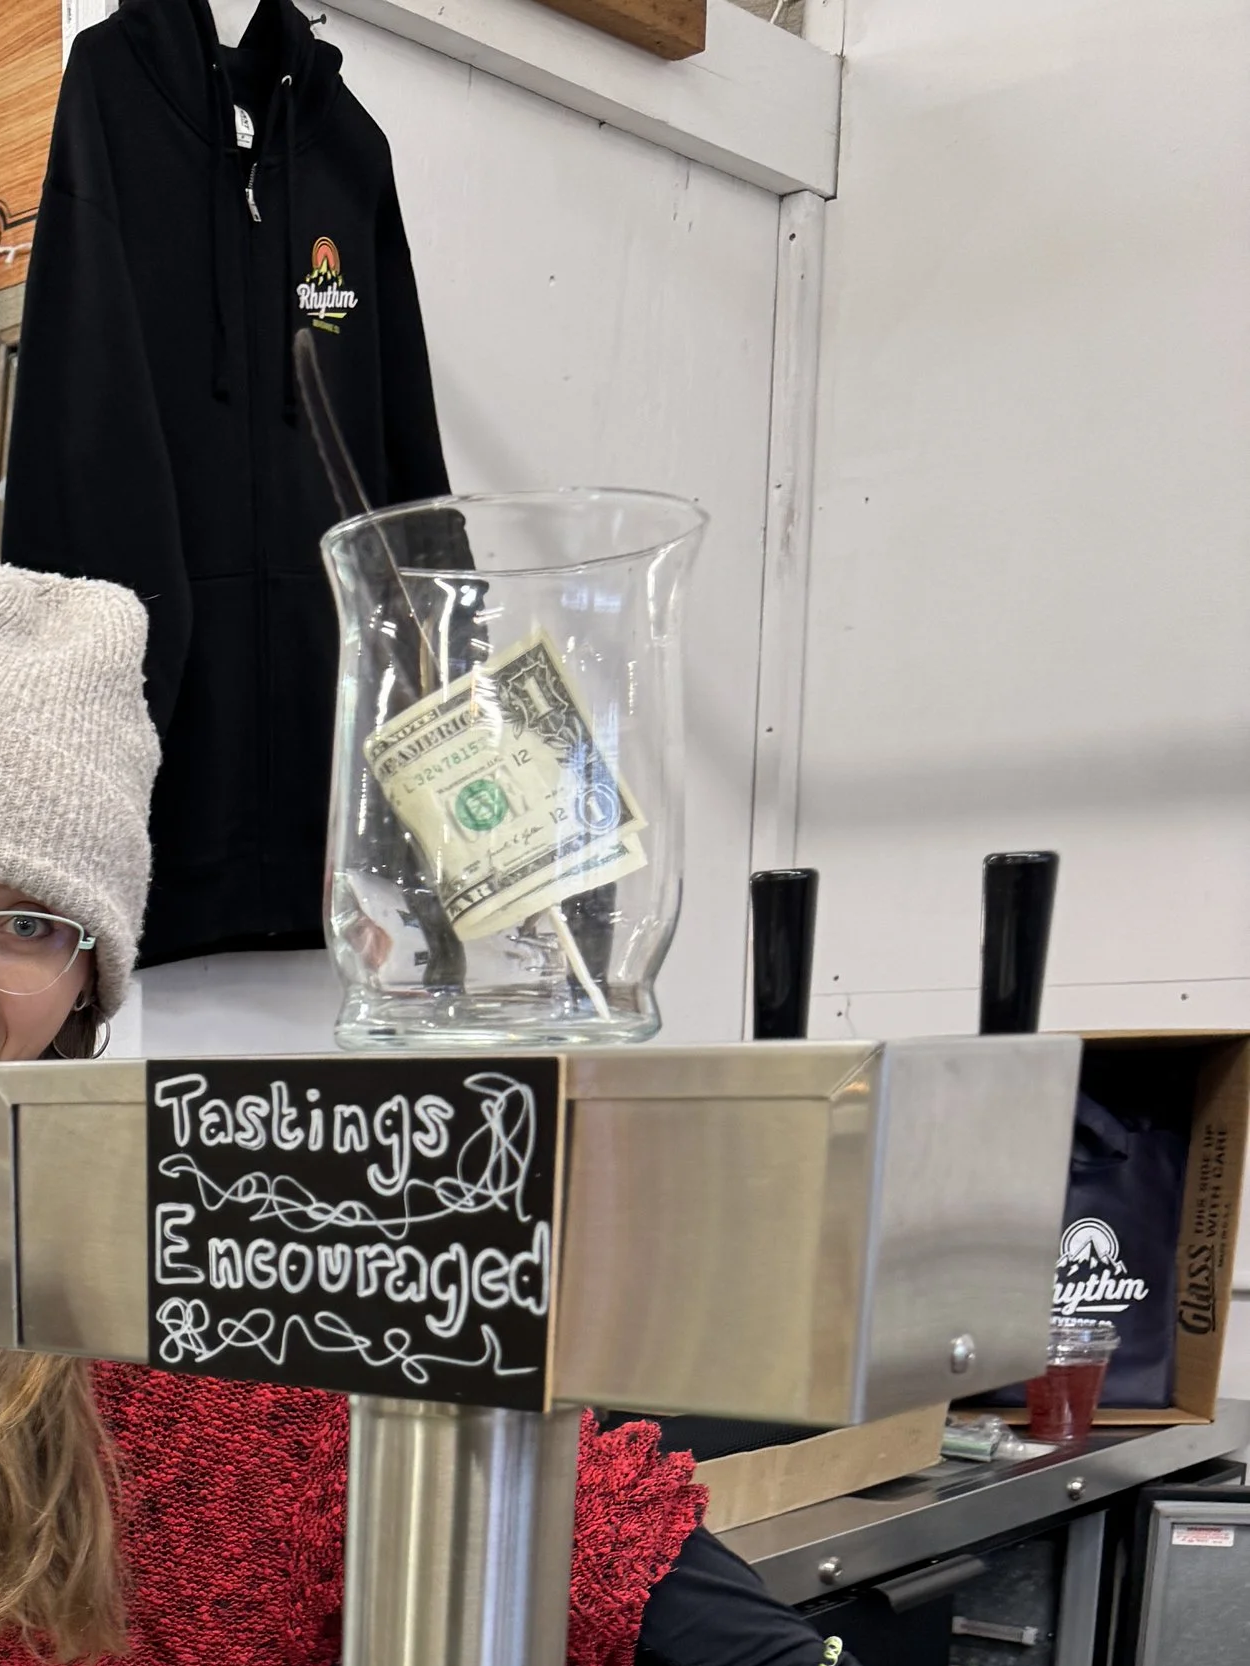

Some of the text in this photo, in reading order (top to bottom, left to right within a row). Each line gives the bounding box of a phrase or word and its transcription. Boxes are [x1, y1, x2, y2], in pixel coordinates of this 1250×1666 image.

[296, 280, 359, 319] Rhythm
[154, 1071, 456, 1197] Tastings
[153, 1201, 552, 1338] Encouraged
[1052, 1268, 1150, 1316] hythm
